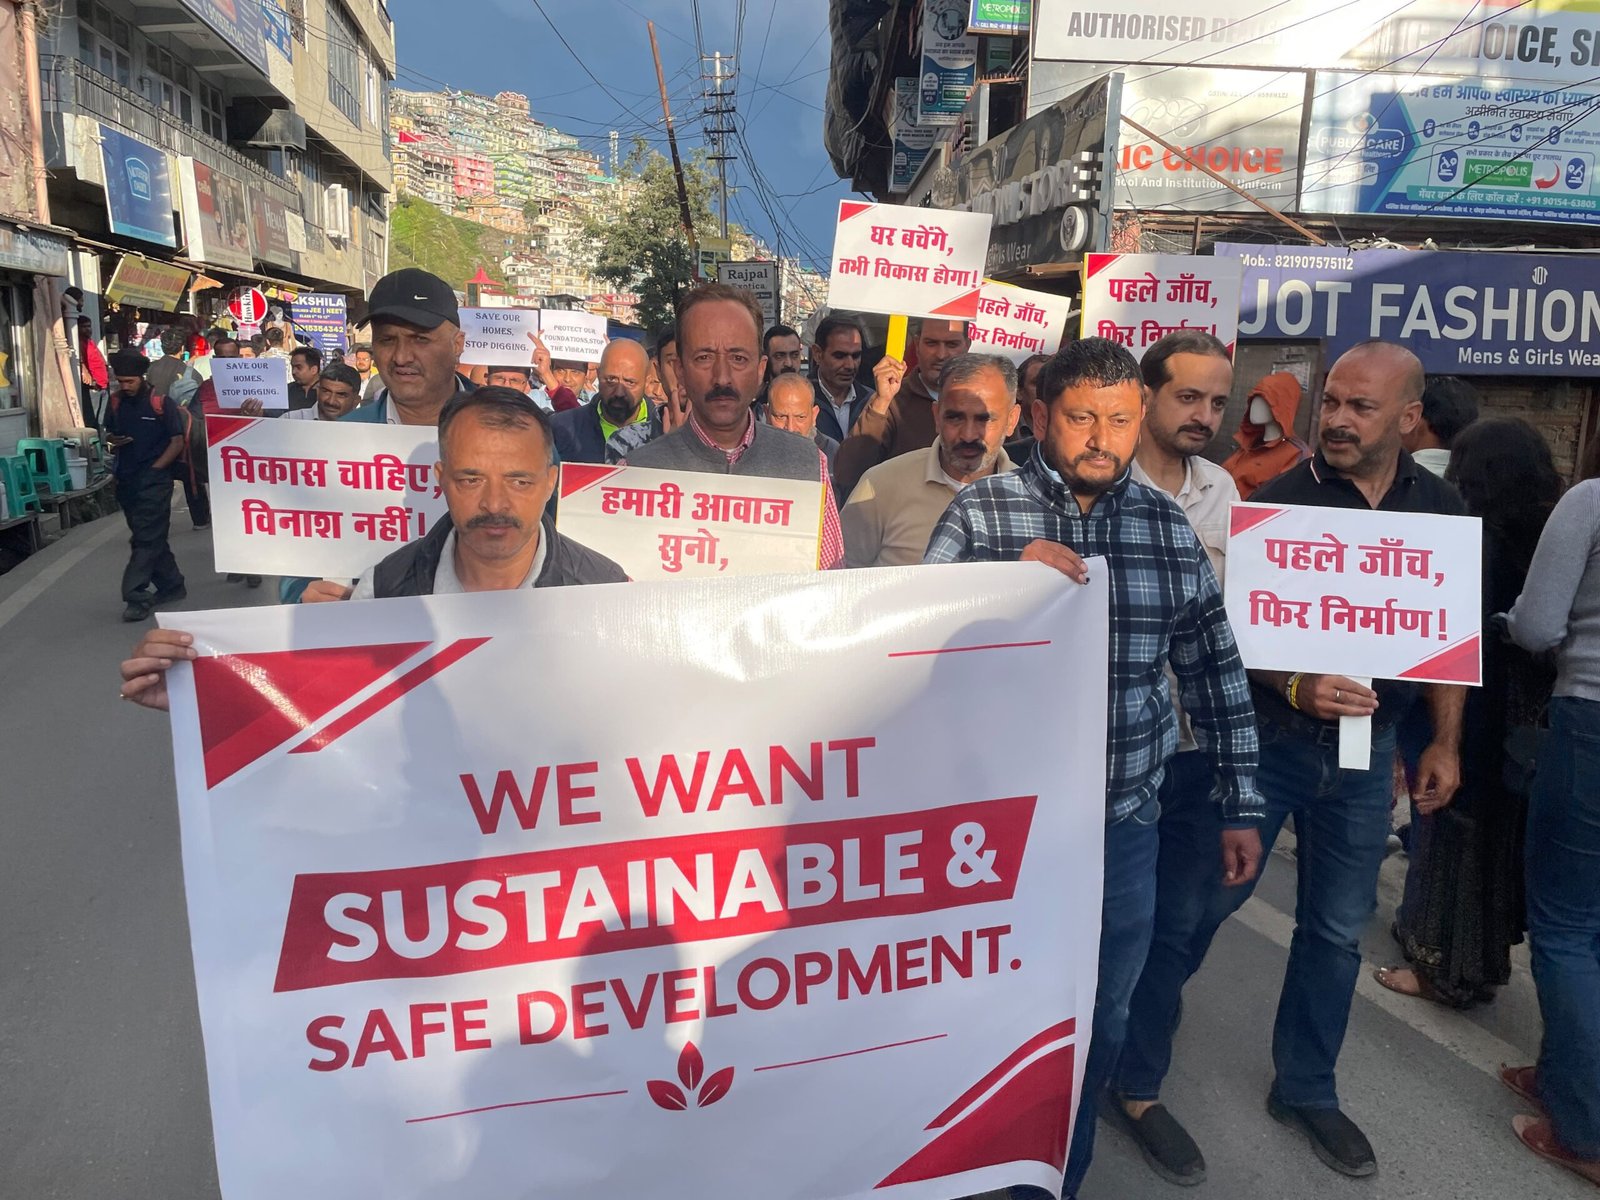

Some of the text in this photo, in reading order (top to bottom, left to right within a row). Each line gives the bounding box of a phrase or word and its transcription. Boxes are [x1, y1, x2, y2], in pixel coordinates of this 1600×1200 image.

[1068, 12, 1206, 42] AUTHORISED
[1116, 144, 1284, 173] IC CHOICE
[1366, 139, 1400, 150] CARE
[1141, 178, 1162, 188] And
[1166, 178, 1237, 189] Institutionl
[1468, 164, 1528, 178] METROPOLIS
[1526, 196, 1542, 205] +91
[1542, 198, 1596, 208] 90154-63805
[870, 224, 954, 257] घर बचेंगे,
[728, 268, 768, 282] Rajpal
[839, 256, 978, 288] तभी विकास होगा!
[1275, 255, 1354, 270] 821907575112
[1109, 272, 1160, 302] पहले
[243, 287, 253, 322] Hawkins
[476, 312, 520, 322] SAVE OUR
[1238, 278, 1352, 336] JOT
[554, 324, 596, 335] PROTECT OUR
[992, 328, 1046, 354] निर्माण!
[466, 340, 529, 352] STOP DIGGING.
[564, 346, 599, 354] VIBRATION
[1458, 347, 1600, 366] Mens & Girls Wea
[220, 446, 443, 500] विकास चाहिए,
[242, 499, 344, 539] विनाश
[601, 482, 794, 526] हमारी आवाज
[658, 528, 730, 573] सुनो,
[1265, 533, 1348, 574] पहले
[1249, 590, 1448, 640] फिर निर्माण!
[459, 736, 876, 834] WE WANT
[324, 821, 1003, 963] SUSTAINABLE &
[306, 924, 1022, 1072] SAFE DEVELOPMENT.
